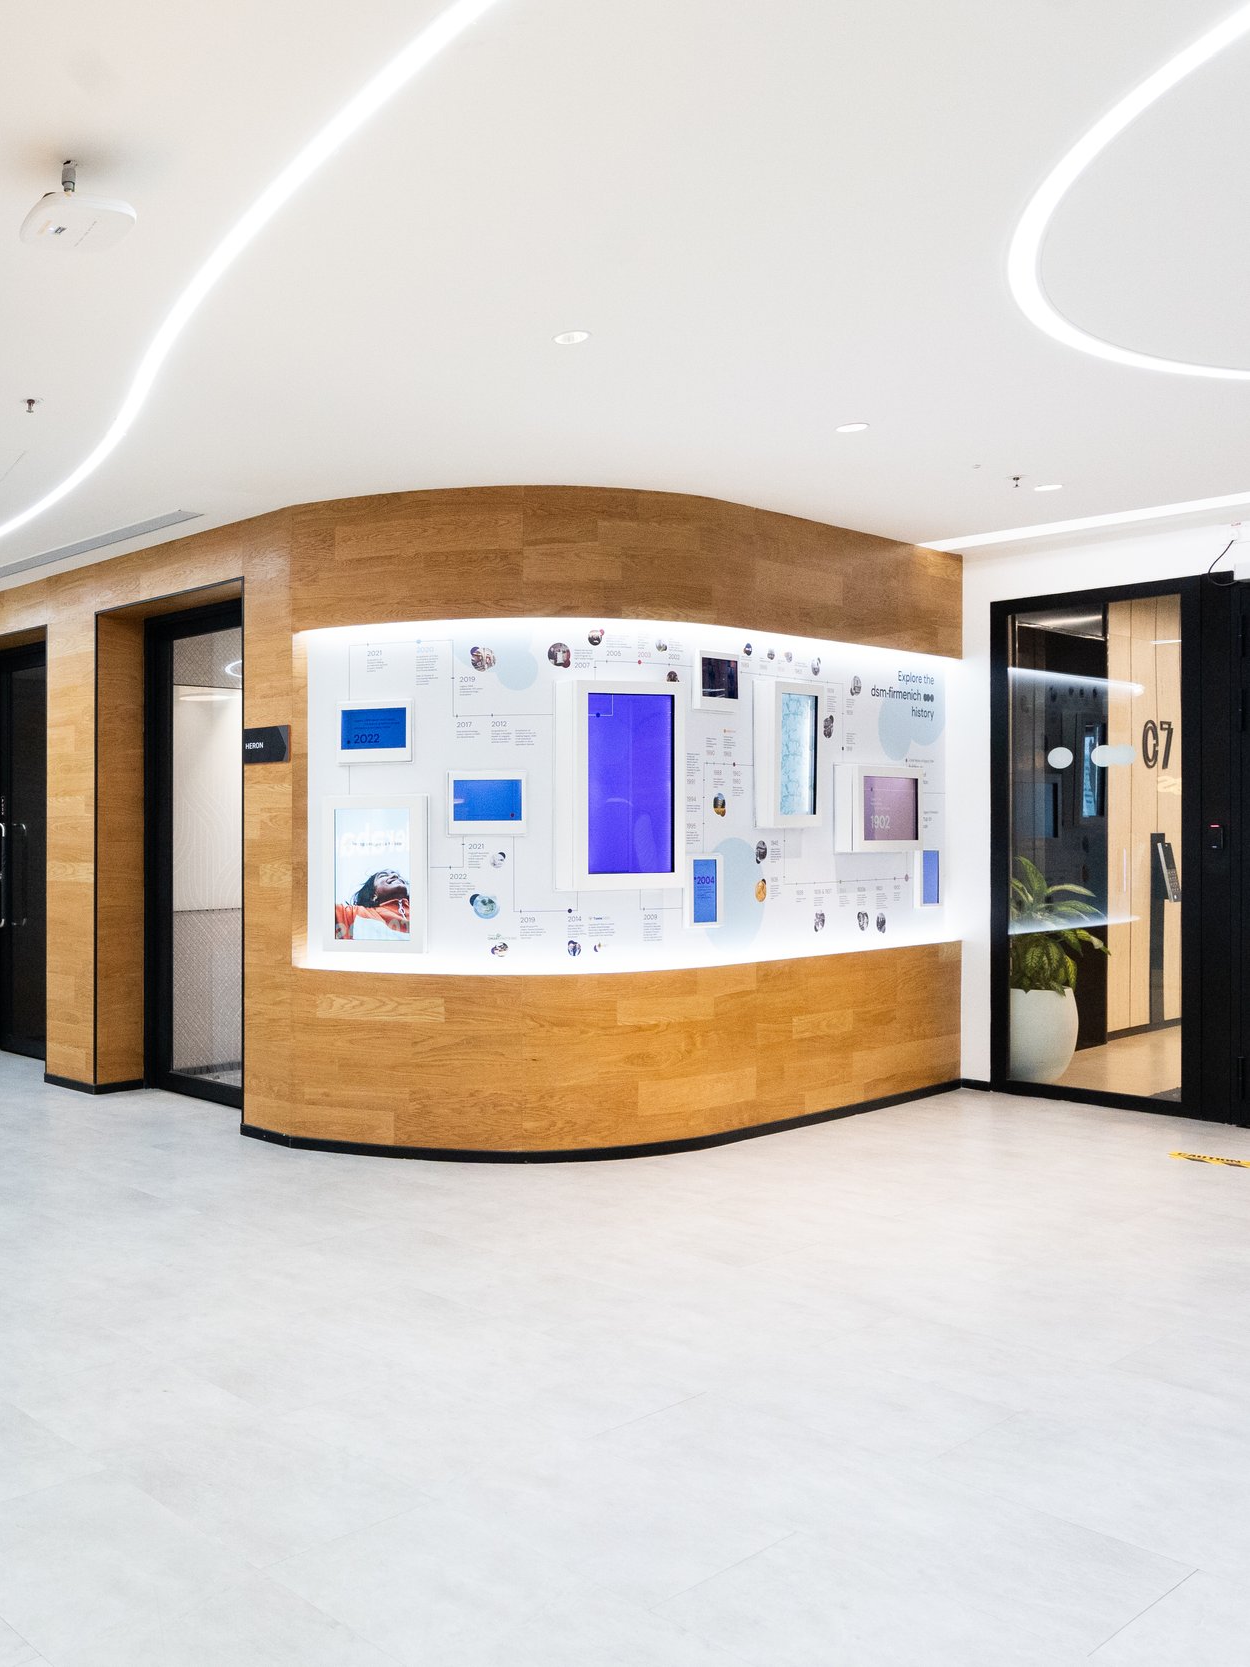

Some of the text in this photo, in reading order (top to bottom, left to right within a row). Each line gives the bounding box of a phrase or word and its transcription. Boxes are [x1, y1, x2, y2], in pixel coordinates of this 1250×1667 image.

[898, 670, 935, 685] Explore the
[871, 684, 922, 701] dsm-firmenich
[911, 706, 935, 721] history
[456, 721, 473, 729] 2017
[491, 720, 508, 728] 2012
[353, 733, 380, 744] 2022
[245, 741, 264, 750] HERON
[1141, 719, 1174, 770] 07
[870, 814, 891, 829] 1902
[696, 876, 715, 885] 2004
[567, 915, 582, 923] 2014
[1177, 1152, 1242, 1164] CAUTION
